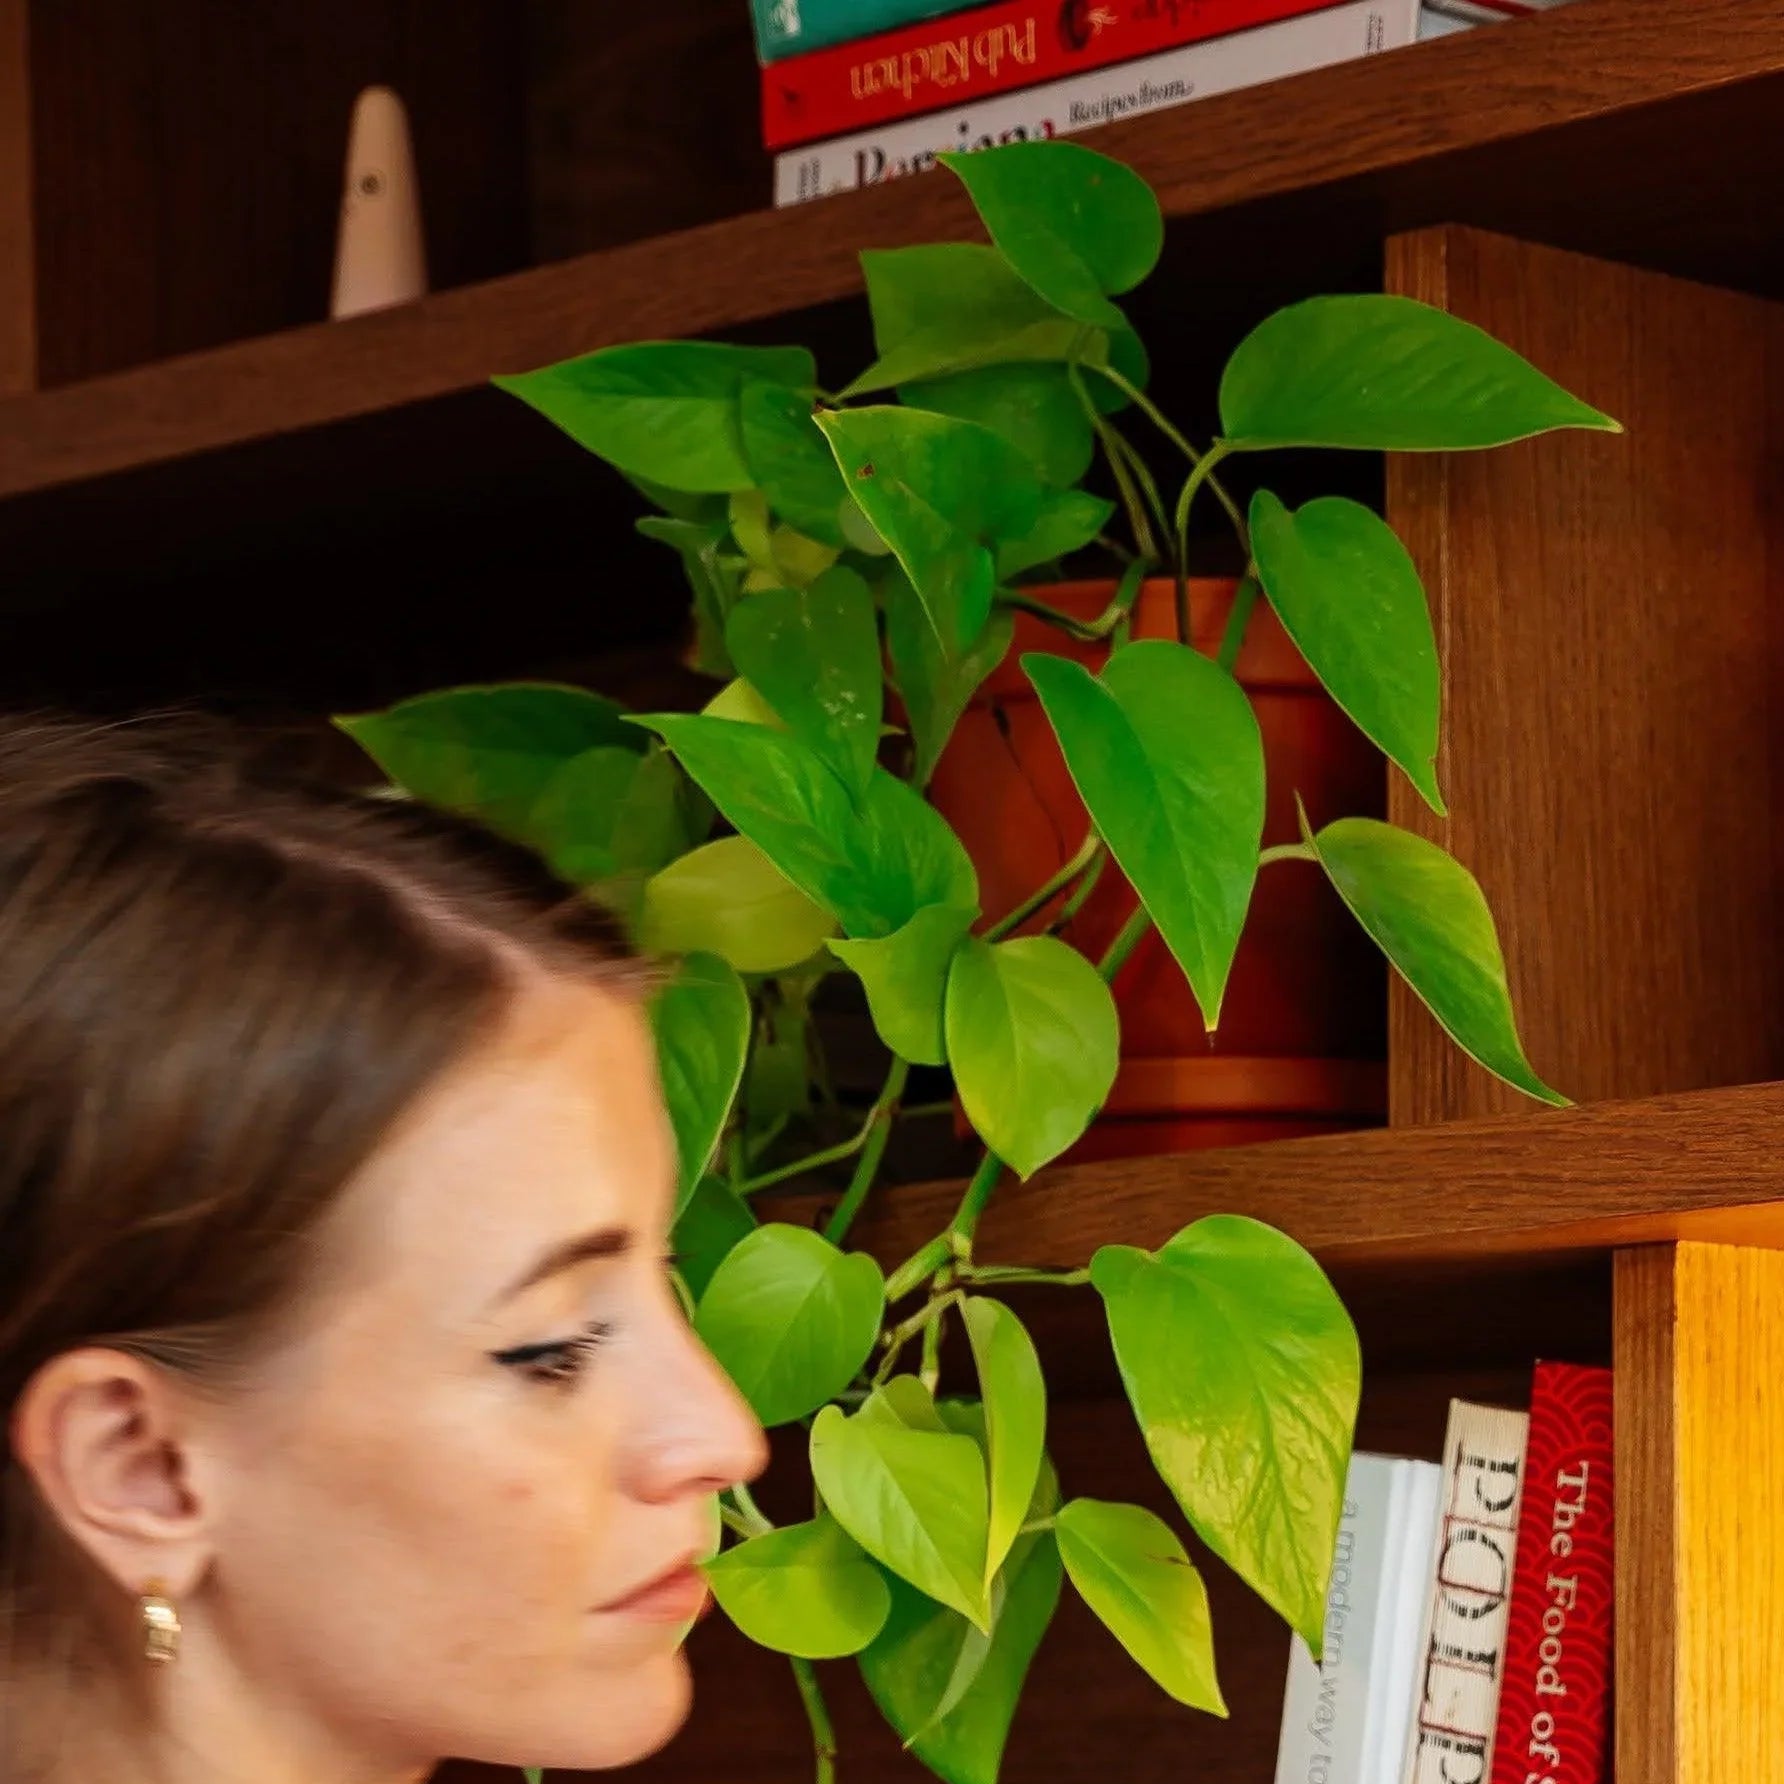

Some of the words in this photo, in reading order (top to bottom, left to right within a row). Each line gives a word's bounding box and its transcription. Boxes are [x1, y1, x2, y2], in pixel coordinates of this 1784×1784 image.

[973, 17, 1036, 78] Pub
[1550, 1460, 1589, 1558] The
[1535, 1572, 1579, 1698] Food
[1307, 1676, 1338, 1746] way
[1529, 1711, 1561, 1768] of
